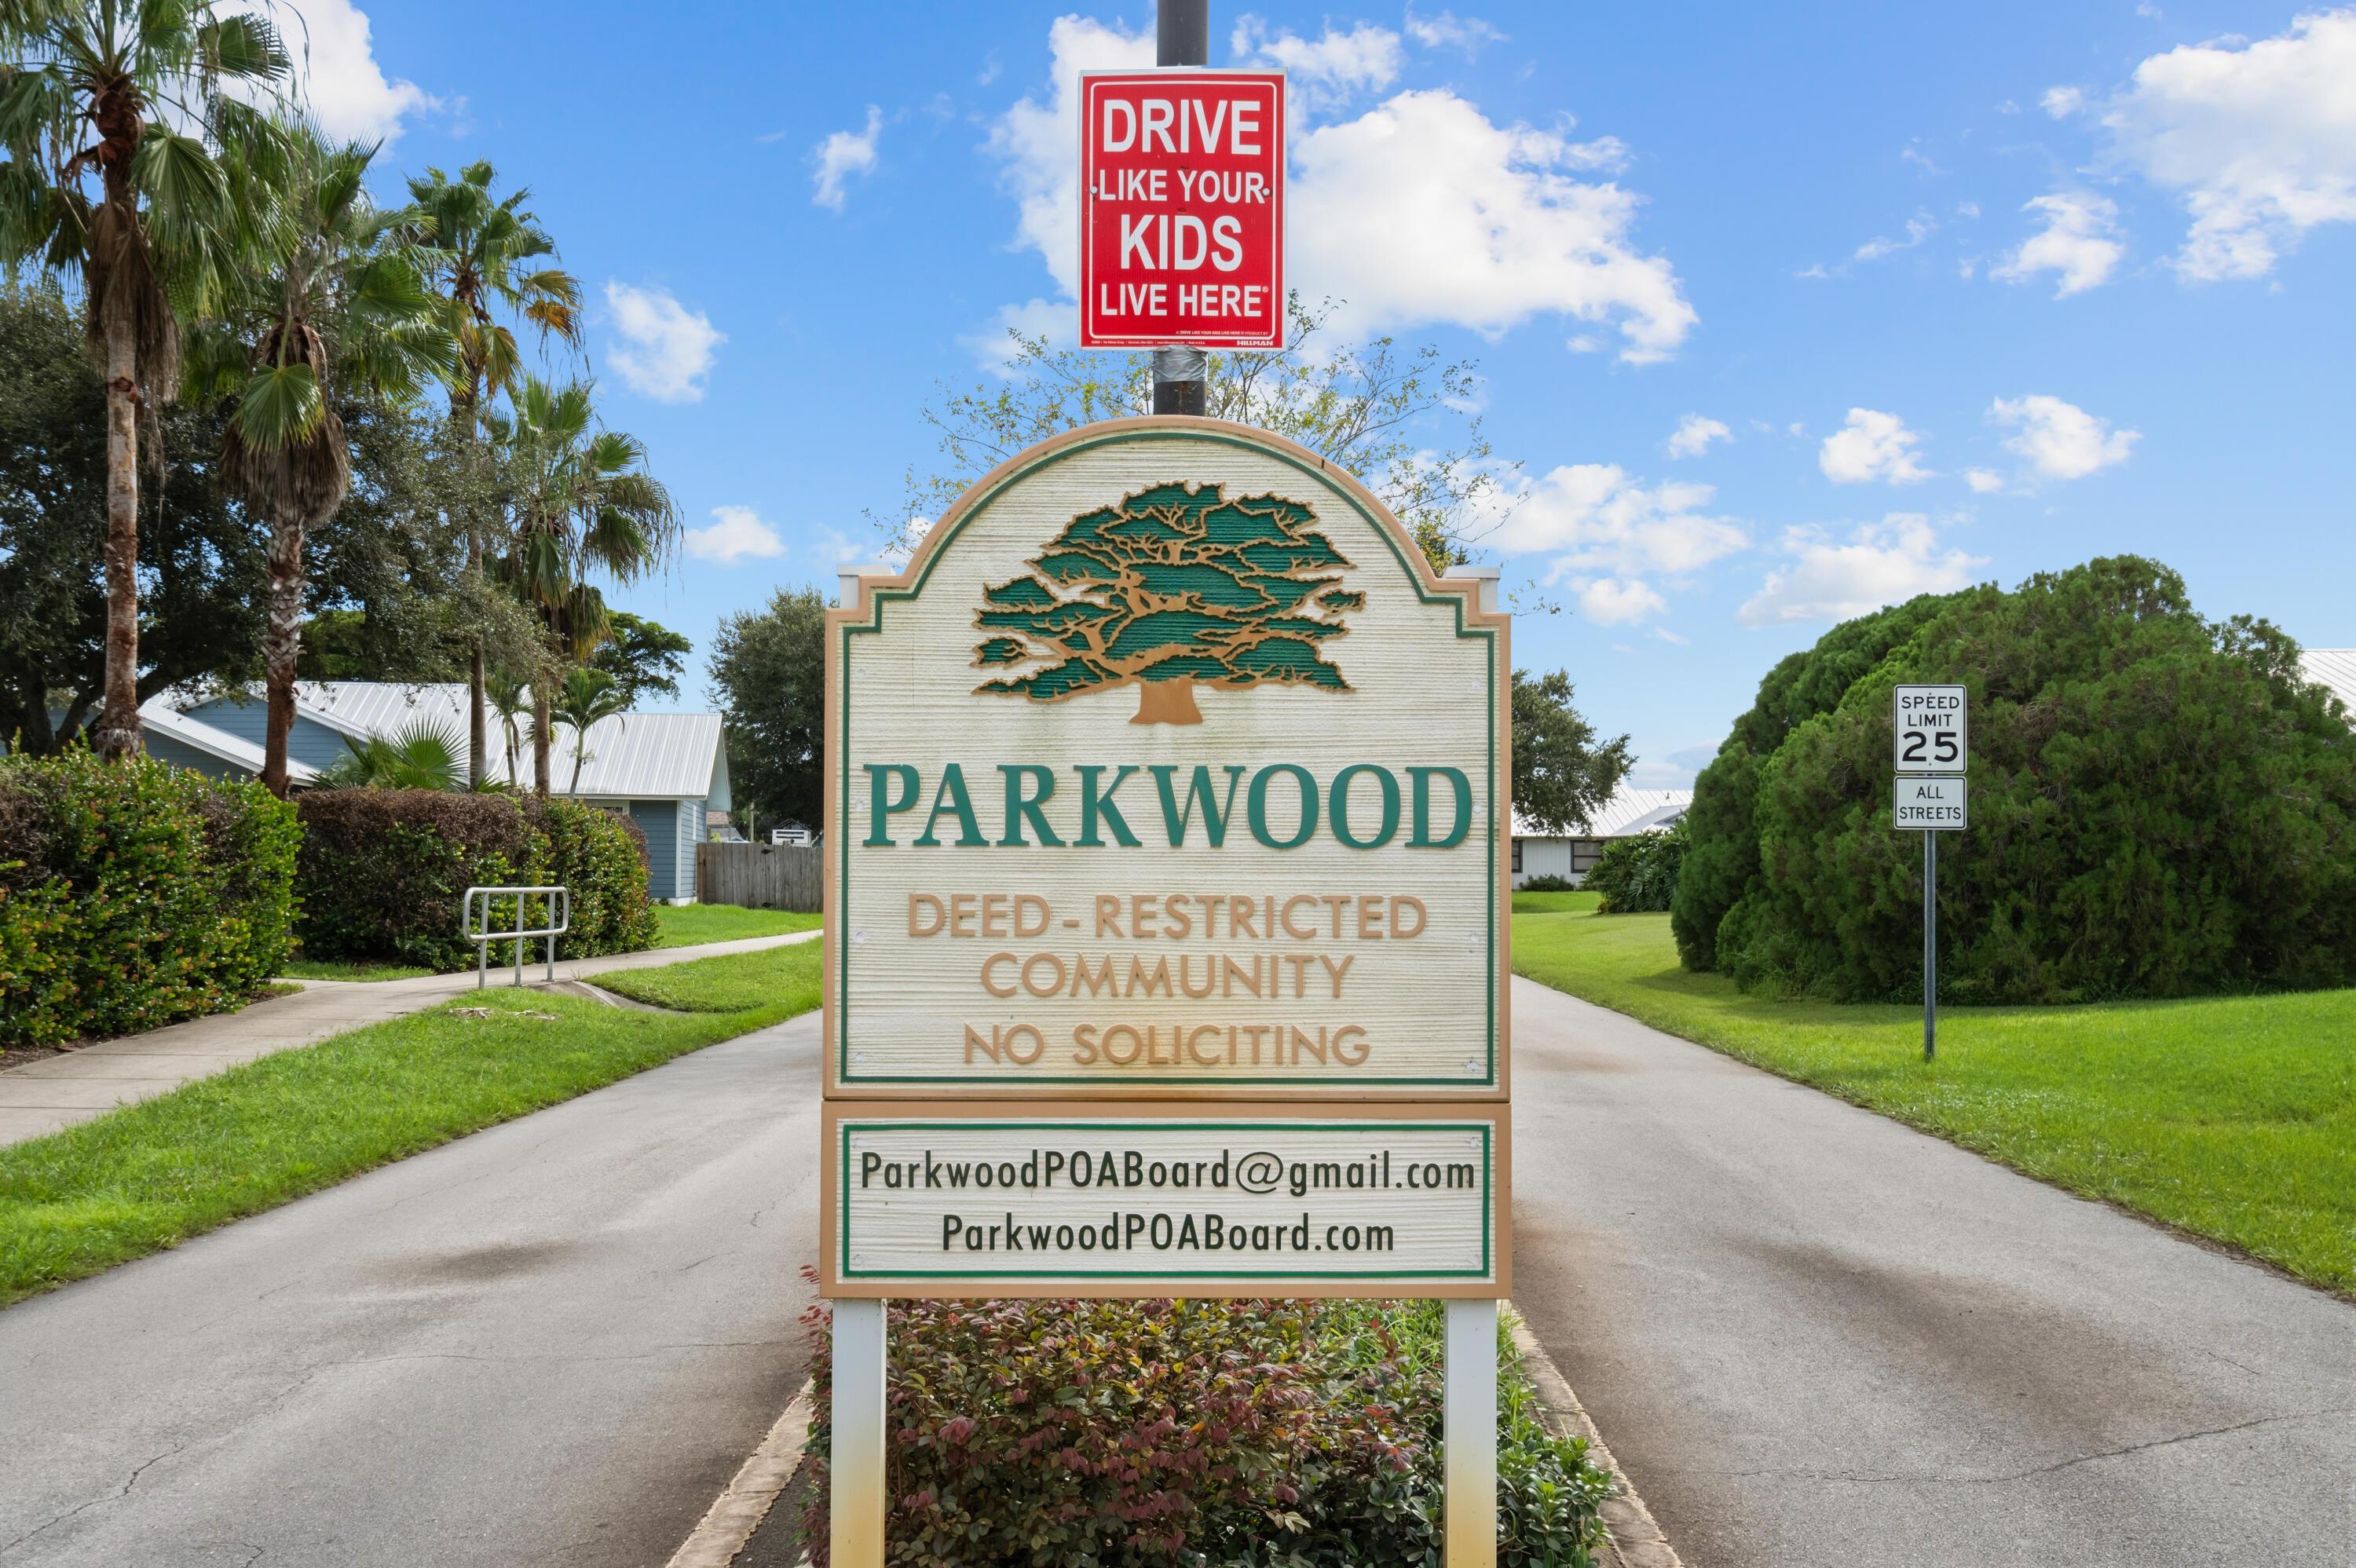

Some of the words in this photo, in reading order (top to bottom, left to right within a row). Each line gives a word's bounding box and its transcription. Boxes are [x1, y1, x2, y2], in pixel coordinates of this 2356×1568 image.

[1103, 99, 1261, 155] DRIVE
[1099, 170, 1168, 201] LIKE
[1177, 170, 1265, 203] YOUR
[1121, 214, 1242, 272] KIDS
[1101, 283, 1167, 316] LIVE
[1901, 696, 1959, 709] SPEED
[1908, 715, 1952, 726] LIMIT
[1902, 732, 1958, 762] 25
[862, 762, 1473, 850] PARKWOOD
[1916, 786, 1944, 799] ALL
[1900, 806, 1961, 820] STREETS
[981, 952, 1354, 999] COMMUNITY
[964, 1023, 1044, 1064] NO
[1073, 1023, 1370, 1065] SOLICITING
[861, 1149, 1475, 1197] ParkwoodPOABoard@gmail.com
[942, 1211, 1394, 1252] ParkwoodPOABoard.com
